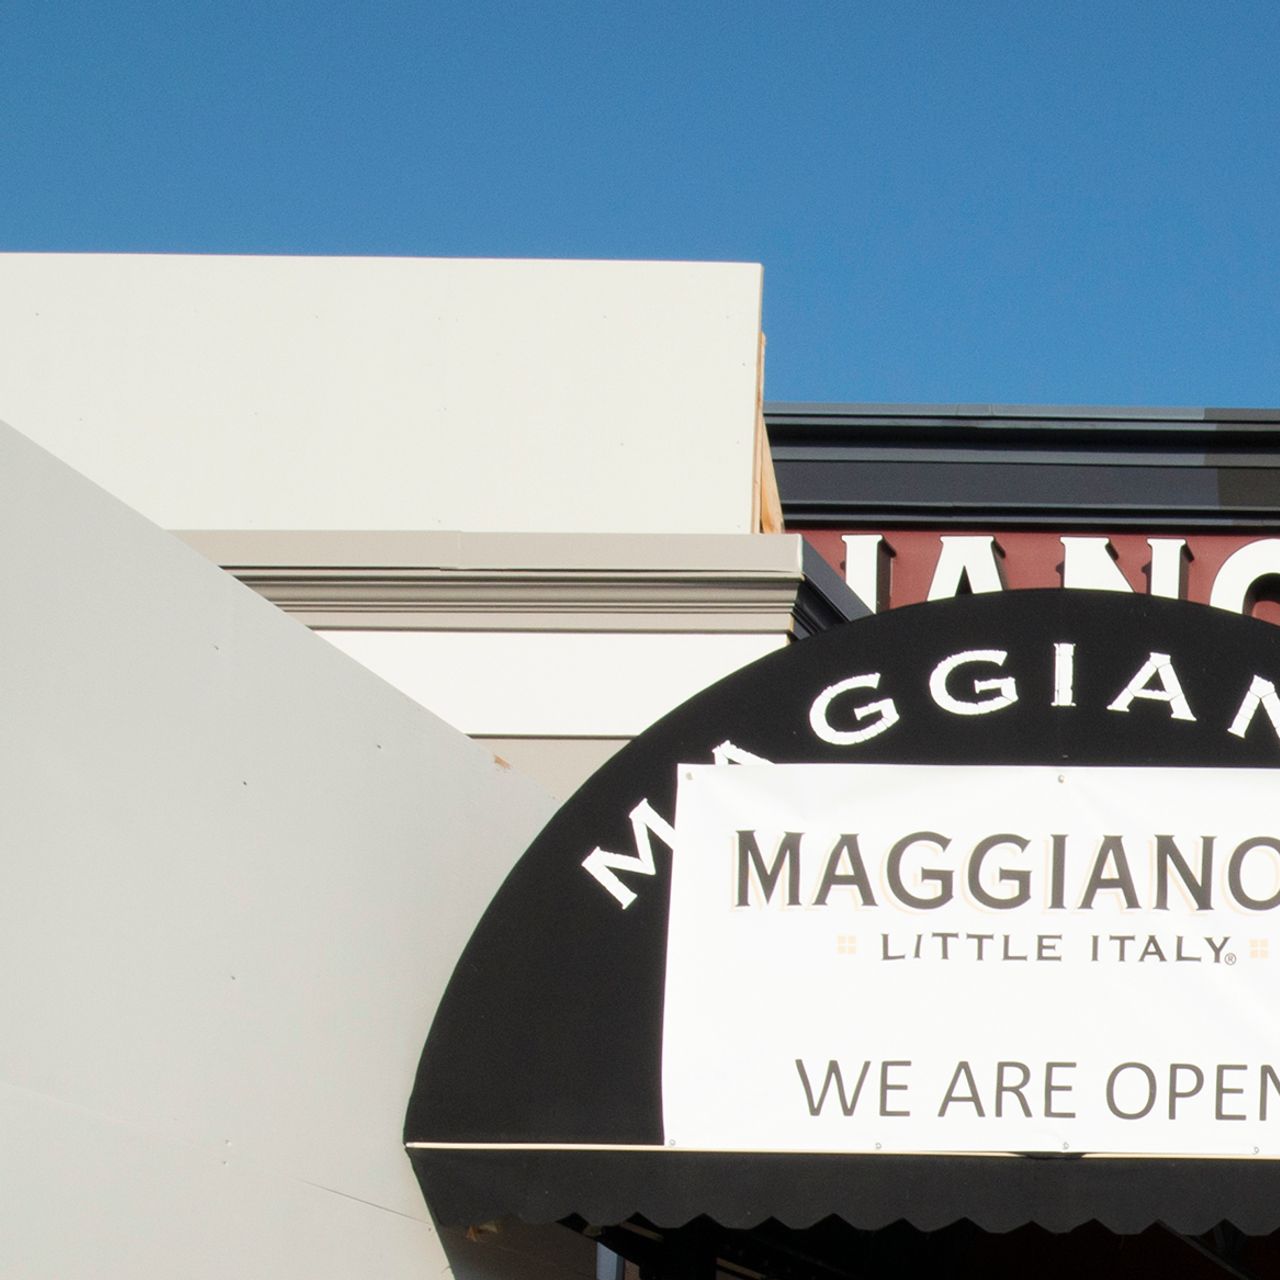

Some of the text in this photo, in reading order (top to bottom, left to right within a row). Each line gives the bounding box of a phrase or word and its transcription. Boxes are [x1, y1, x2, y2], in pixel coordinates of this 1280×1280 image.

[880, 932, 1063, 963] LITTLE
[794, 1058, 912, 1118] WE
[936, 1060, 1077, 1119] ARE
